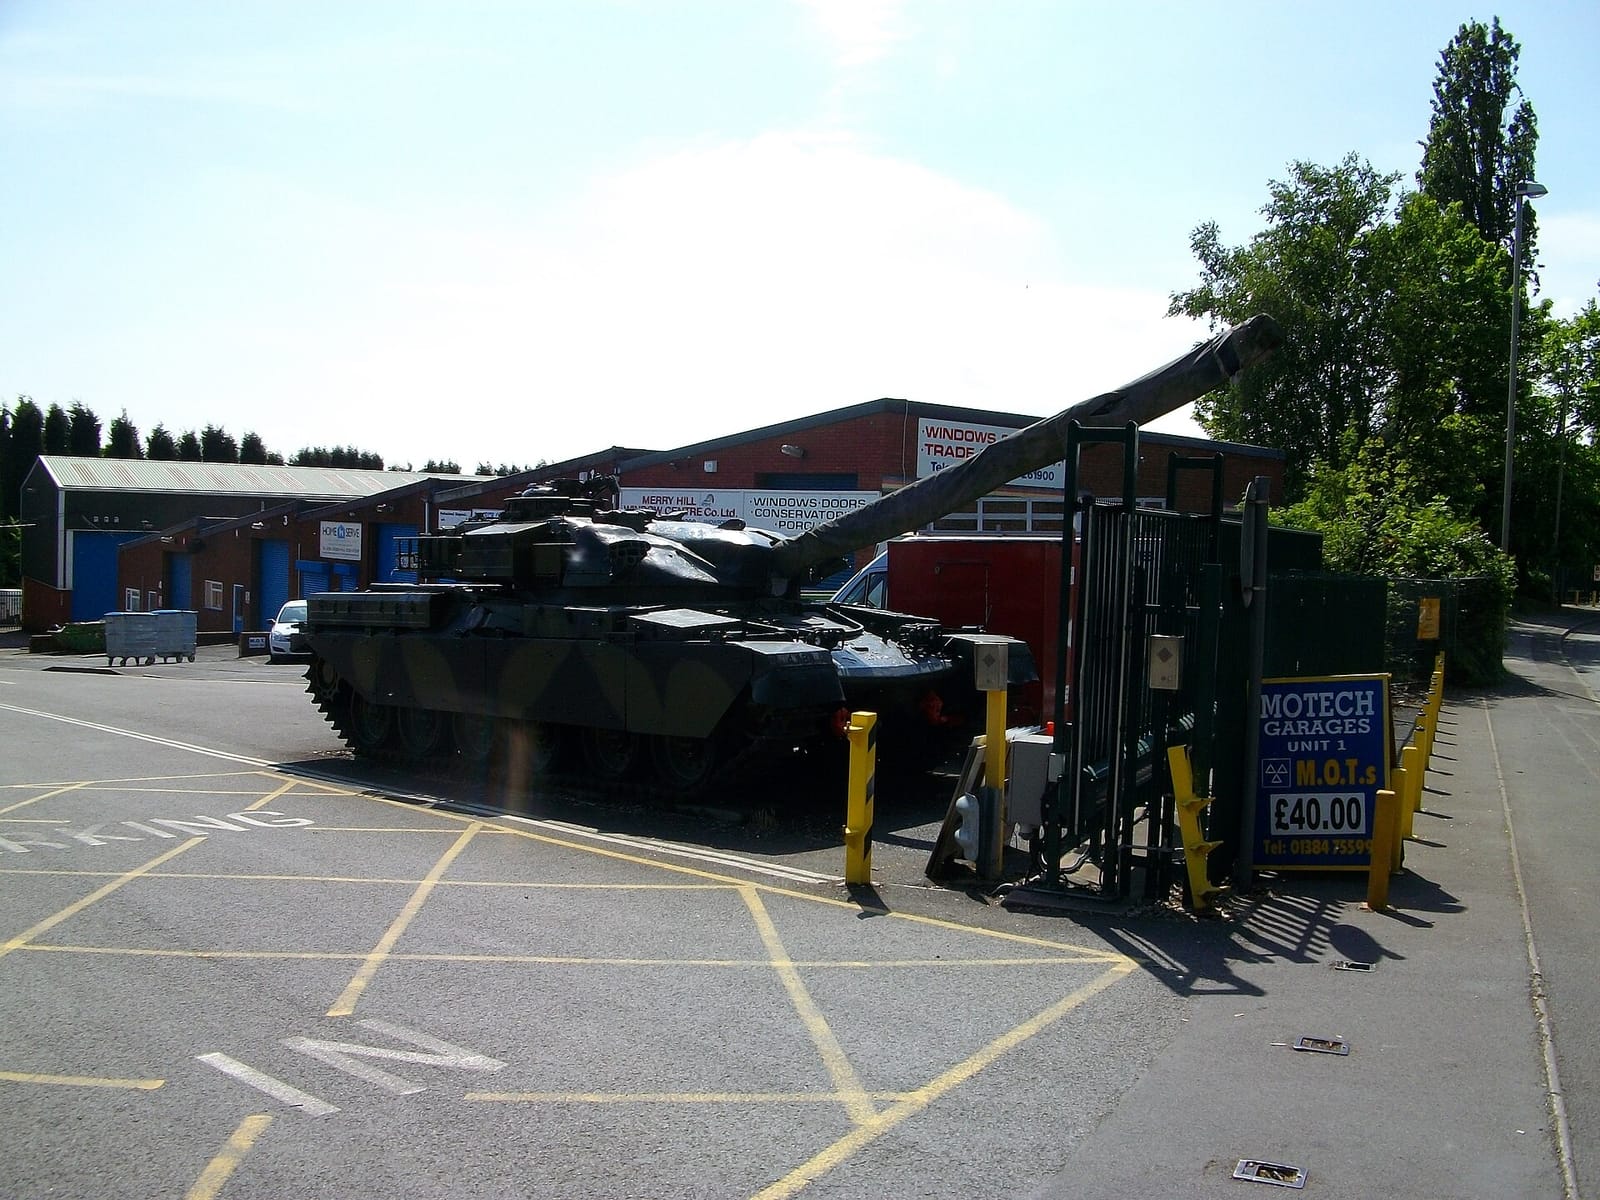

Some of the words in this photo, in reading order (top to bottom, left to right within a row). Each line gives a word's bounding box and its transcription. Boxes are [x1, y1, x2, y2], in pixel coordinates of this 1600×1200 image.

[925, 425, 996, 443] WINDOWS
[924, 443, 975, 459] TRADE
[642, 495, 674, 505] MERRY
[676, 496, 697, 506] HILL
[753, 497, 817, 508] WINDOWS
[821, 498, 866, 509] DOORS
[720, 508, 738, 518] Ltd.
[754, 508, 850, 520] CONSERVATOR
[1260, 690, 1375, 719] MOTECH
[1264, 718, 1371, 736] GARAGES
[1287, 740, 1330, 752] UNIT
[1336, 740, 1347, 751] 1
[1296, 758, 1377, 786] M.O.T.s
[1274, 796, 1362, 831] £40.00
[1263, 839, 1286, 855] Tel:
